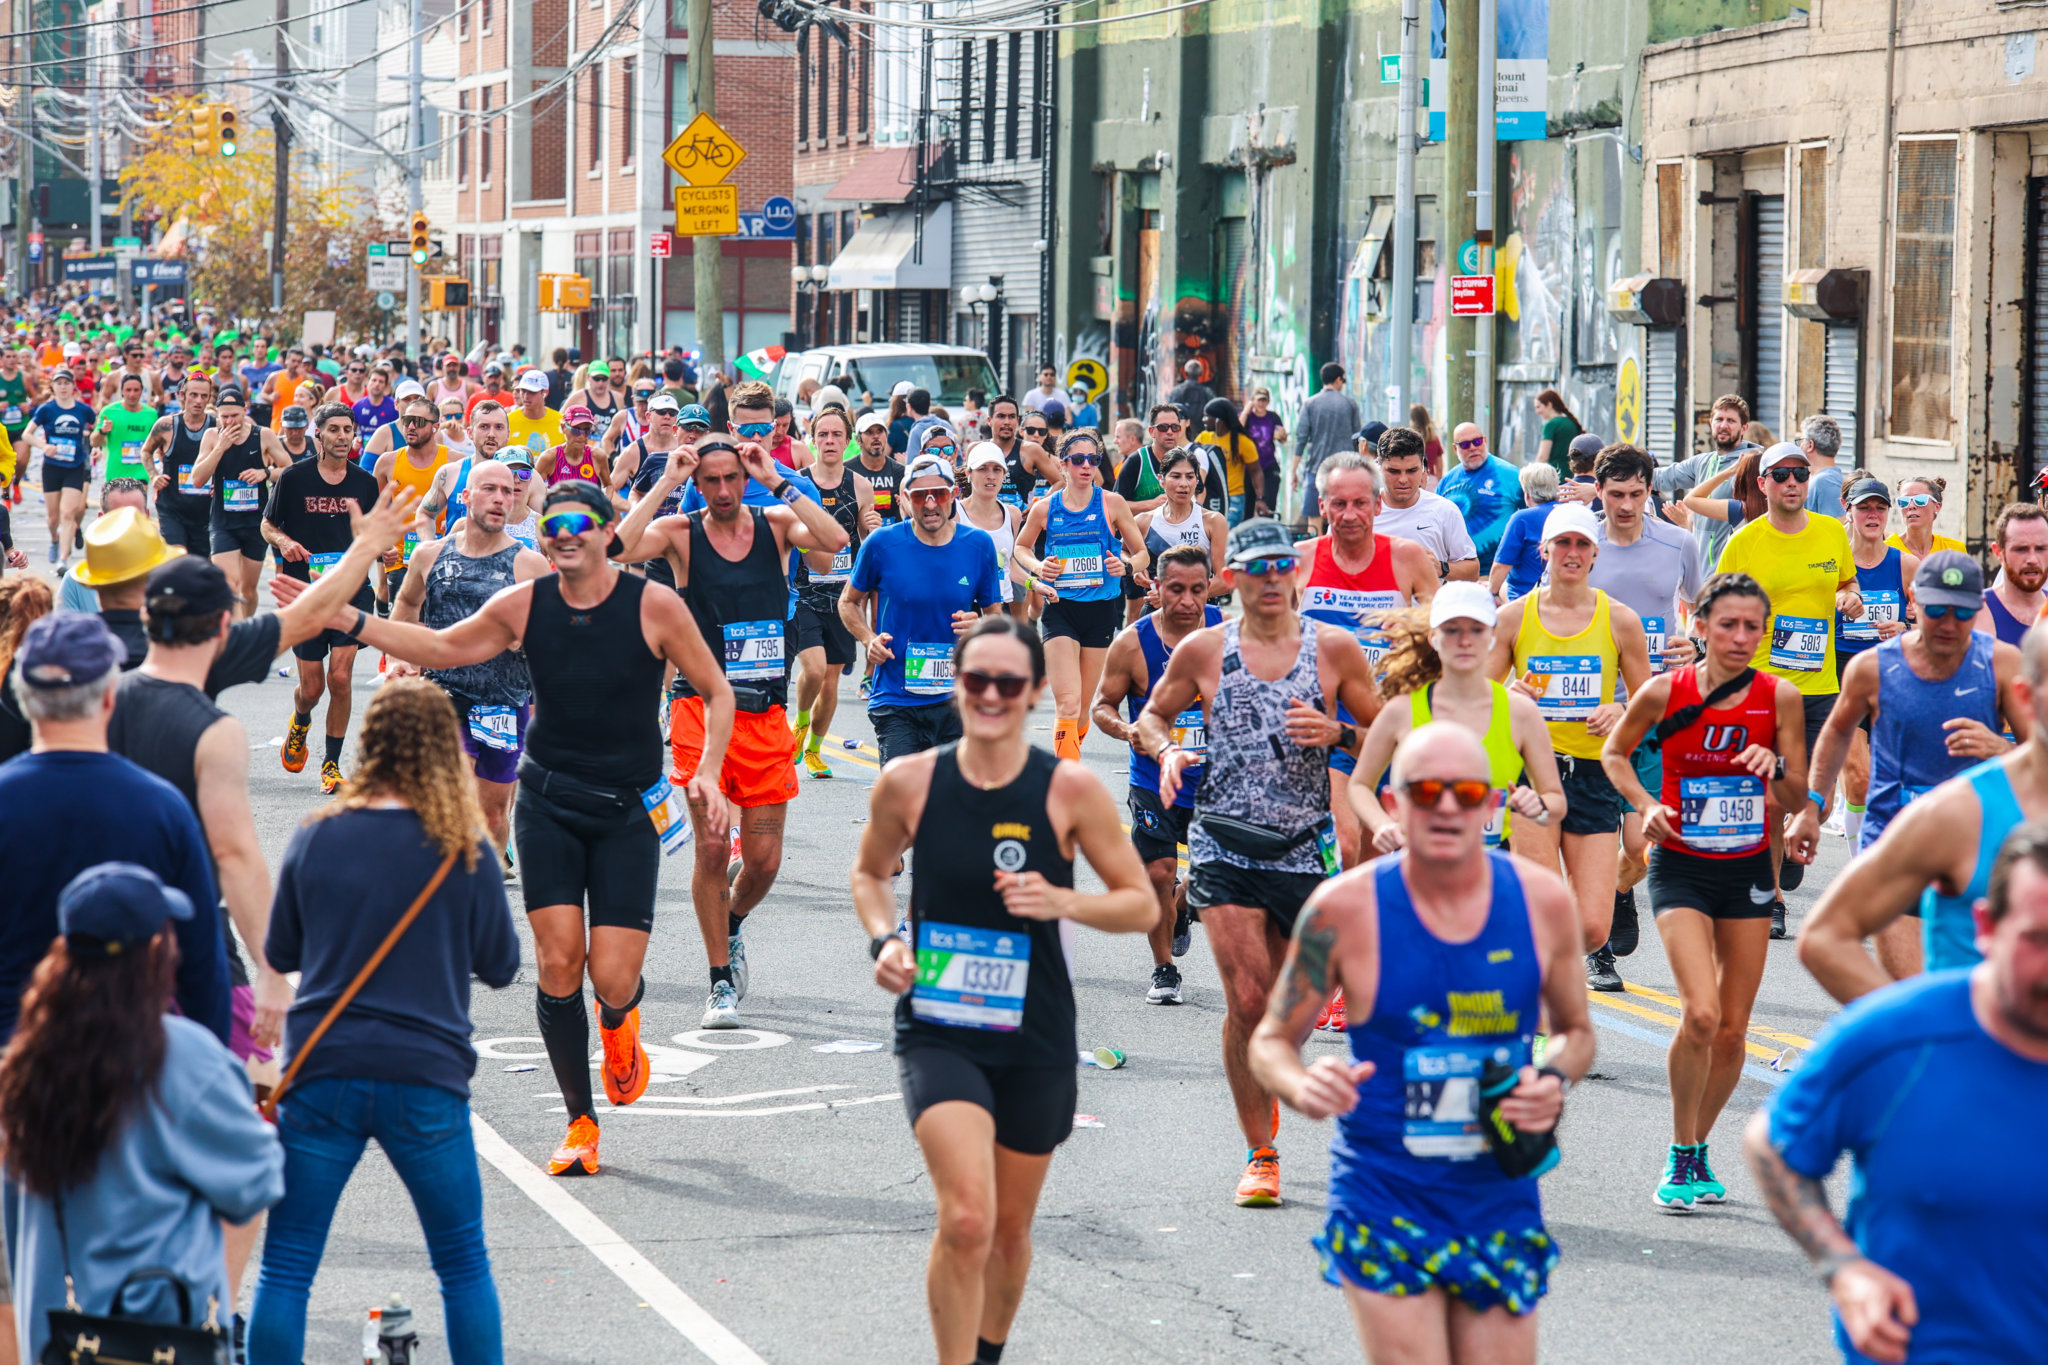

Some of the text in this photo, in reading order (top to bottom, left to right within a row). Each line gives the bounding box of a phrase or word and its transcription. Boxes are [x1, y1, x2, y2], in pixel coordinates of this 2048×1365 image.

[1497, 72, 1525, 81] ount
[1497, 82, 1518, 92] inai
[1496, 94, 1528, 104] ueens
[681, 190, 731, 200] CYCLISTS
[684, 205, 729, 216] MERGING
[694, 220, 720, 230] LEFT
[738, 218, 765, 236] AR
[1453, 279, 1488, 288] NO STOPPING
[1454, 289, 1476, 298] Anytime
[240, 489, 254, 500] 11164
[1180, 532, 1198, 540] NYC
[1055, 546, 1099, 556] AMANDA
[1072, 558, 1098, 572] 12609
[1868, 606, 1892, 620] 5679
[1781, 619, 1794, 628] tcs
[730, 628, 745, 636] tcs
[1646, 636, 1657, 652] 14
[1800, 634, 1820, 652] 5813
[754, 640, 778, 658] 7595
[912, 646, 926, 656] tcs
[1534, 660, 1551, 671] tcs
[1562, 676, 1590, 696] 8441
[1684, 753, 1728, 762] RACING
[1688, 781, 1708, 794] tcs
[1692, 800, 1696, 808] 1
[1720, 800, 1753, 822] 9458
[930, 930, 955, 948] tcs
[962, 958, 1014, 992] 13337
[1418, 1054, 1449, 1075] tcs
